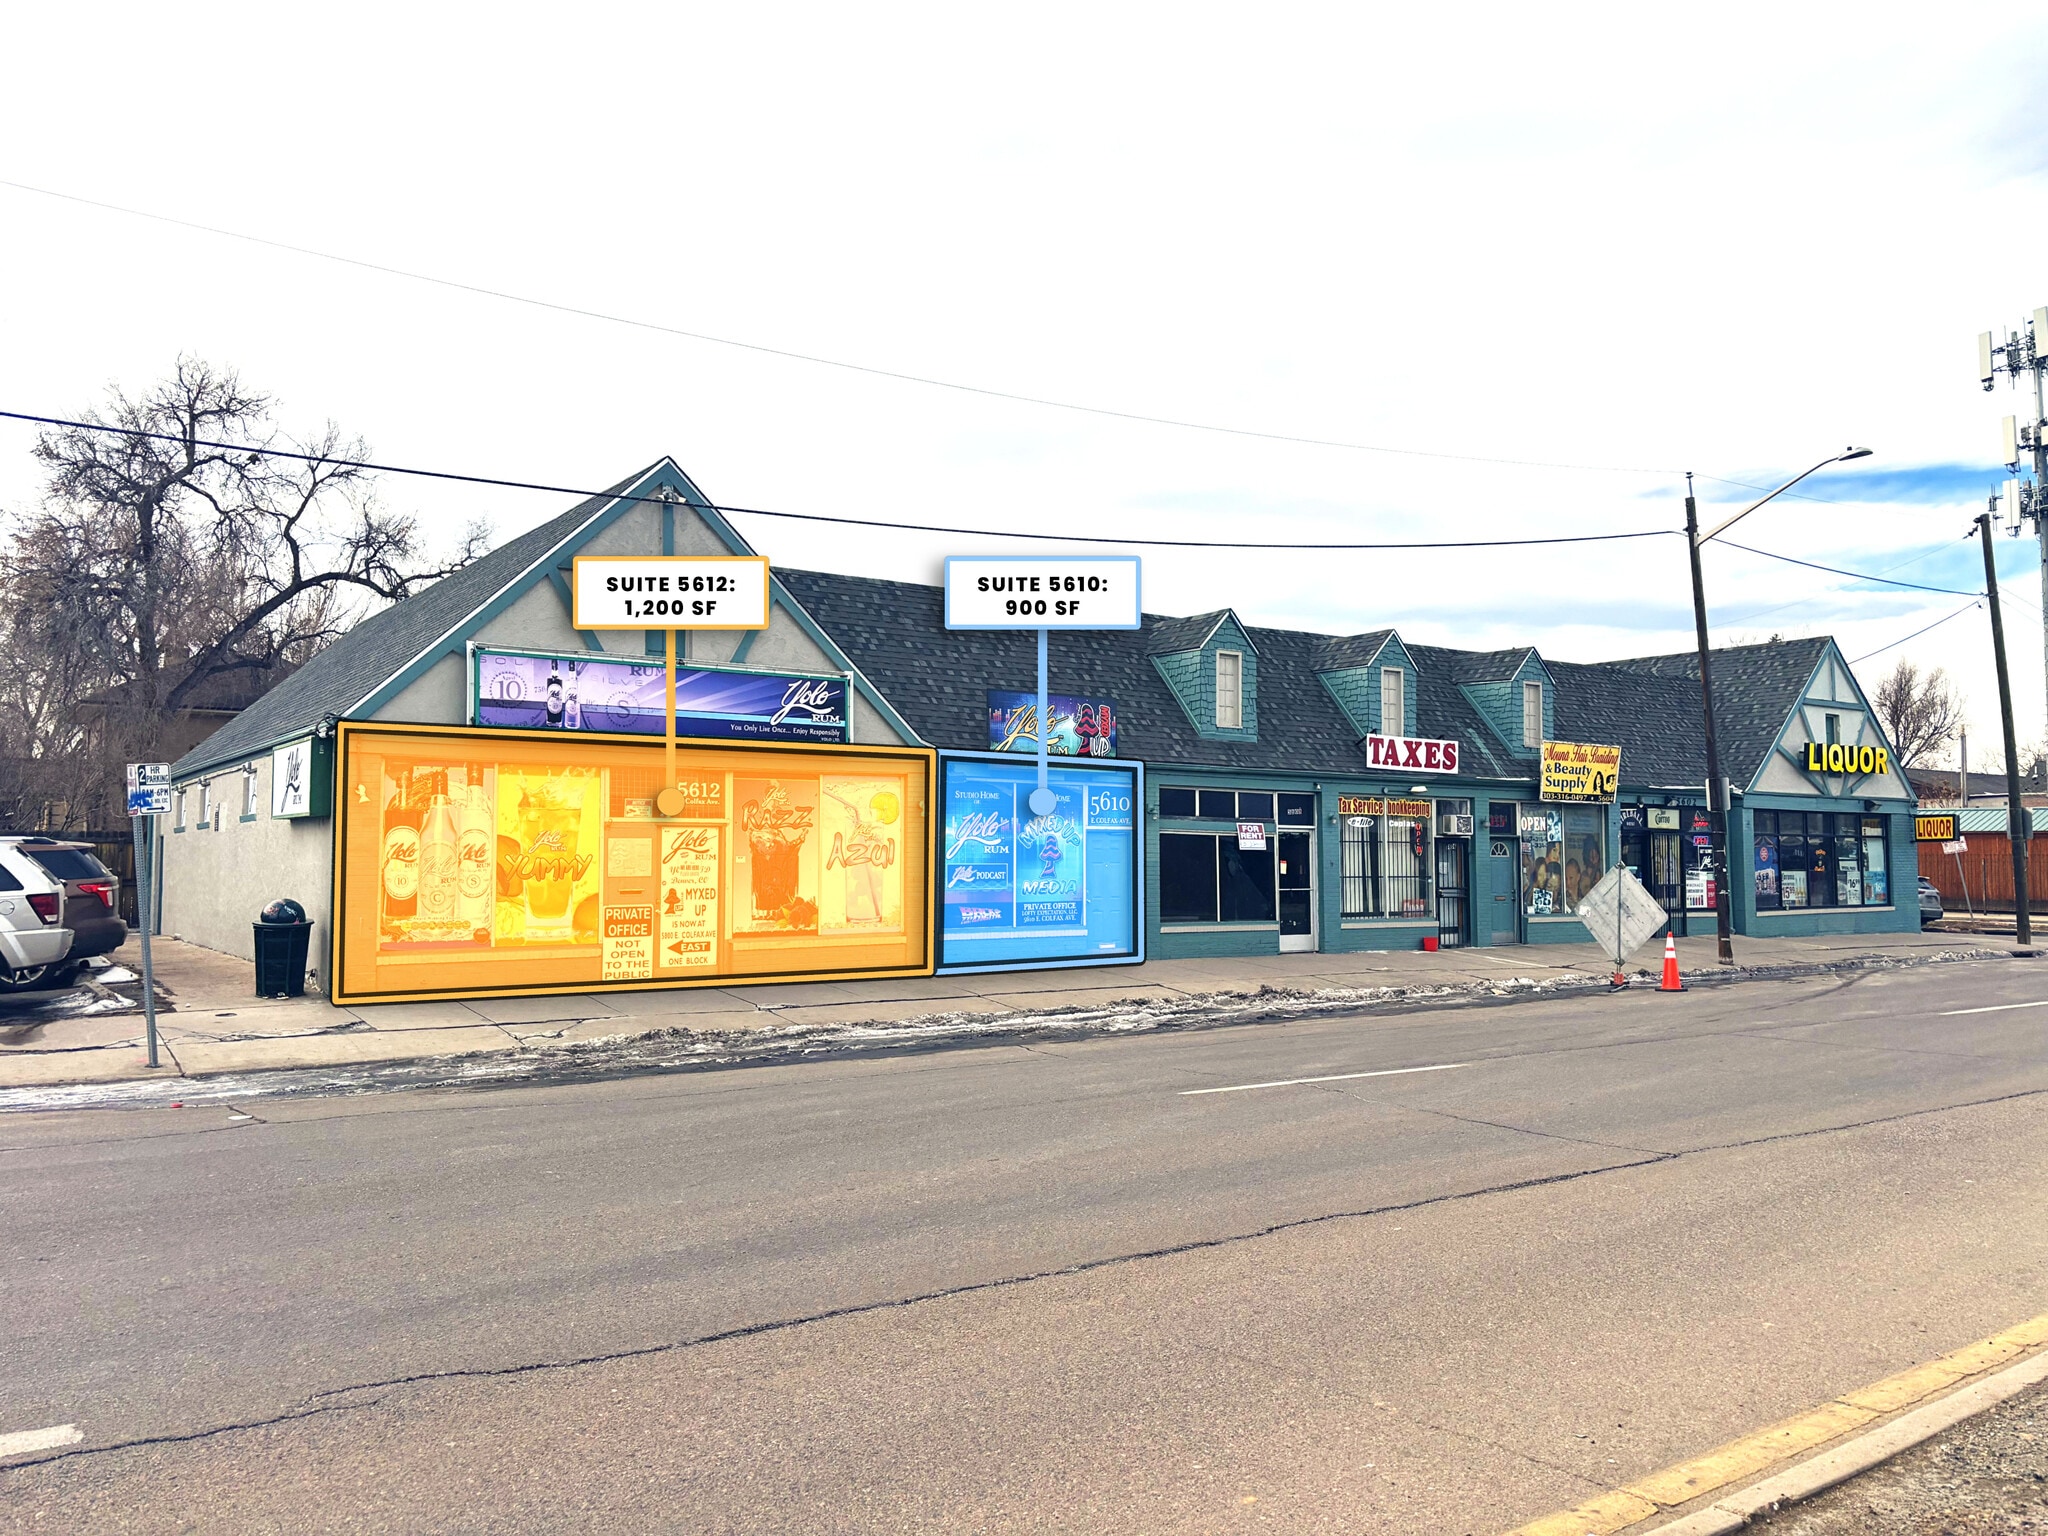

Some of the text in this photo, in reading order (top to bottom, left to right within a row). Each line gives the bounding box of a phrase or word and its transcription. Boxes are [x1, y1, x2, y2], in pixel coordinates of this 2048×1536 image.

[499, 680, 522, 700] 10
[770, 680, 840, 725] Yolo
[811, 714, 841, 724] RUM
[744, 724, 758, 734] Only
[759, 725, 771, 733] Live
[809, 728, 841, 737] Responsibly
[1090, 737, 1111, 757] UP
[1368, 736, 1457, 770] TAXES
[1571, 744, 1588, 762] Hair
[1589, 746, 1619, 769] Braiding
[1808, 742, 1889, 774] LIQUOR
[139, 768, 146, 783] 2
[150, 766, 160, 774] HR
[1545, 762, 1592, 779] & Beauty
[146, 774, 169, 782] PARKING
[1545, 776, 1587, 792] Supply
[678, 782, 720, 798] 5612
[955, 791, 1000, 799] STUDIO HOME
[1090, 791, 1130, 815] 5610
[1338, 797, 1384, 815] Tax Service
[1387, 798, 1430, 818] bookkeeping
[1521, 816, 1546, 831] OPEN
[1917, 819, 1952, 838] LIQUOR
[946, 811, 1009, 860] Yolo
[1018, 815, 1081, 849] MYXED UP
[663, 829, 717, 864] Yolo
[984, 845, 1009, 854] RUM
[976, 871, 1006, 880] PODCAST
[686, 888, 716, 900] MYXED
[1022, 880, 1077, 895] MEDIA
[433, 893, 441, 902] C
[695, 905, 707, 916] UP
[1052, 902, 1077, 910] OFFICE
[605, 908, 651, 920] PRIVATE
[608, 924, 648, 936] OFFICE
[680, 920, 697, 928] NOW
[706, 930, 716, 938] AVE
[615, 940, 641, 948] NOT
[681, 943, 707, 951] EAST
[610, 950, 645, 959] OPEN
[686, 957, 708, 965] BLOCK
[606, 960, 650, 969] TO THE
[604, 970, 650, 980] PUBLIC
